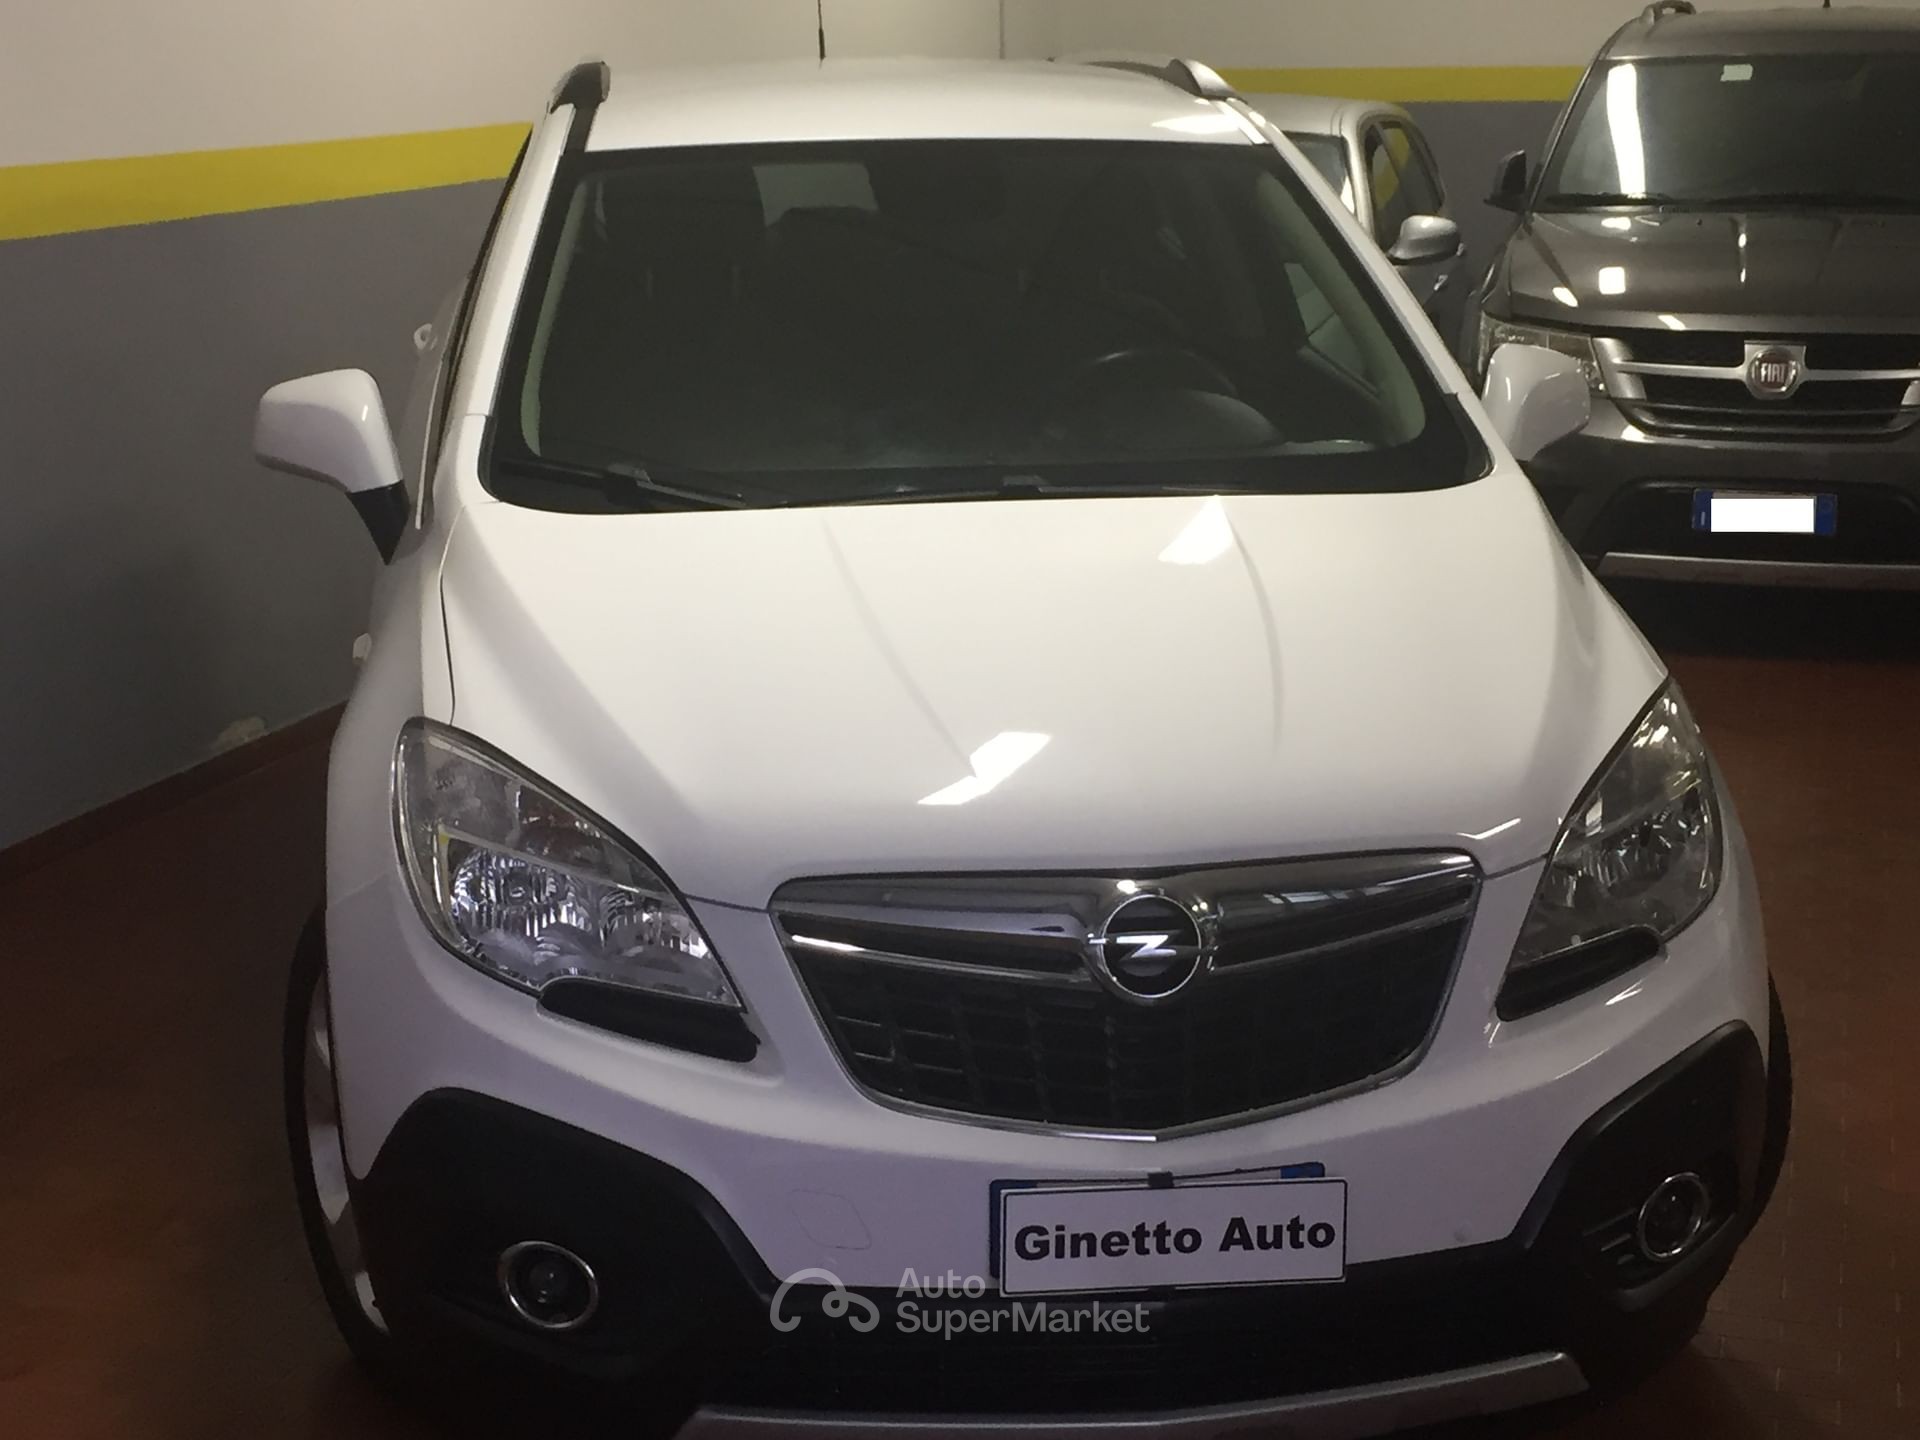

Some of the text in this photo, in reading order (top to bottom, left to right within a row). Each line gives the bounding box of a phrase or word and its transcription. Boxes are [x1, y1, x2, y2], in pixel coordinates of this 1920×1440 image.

[1761, 362, 1787, 382] FIAT
[1014, 1215, 1336, 1261] Ginetto Auto
